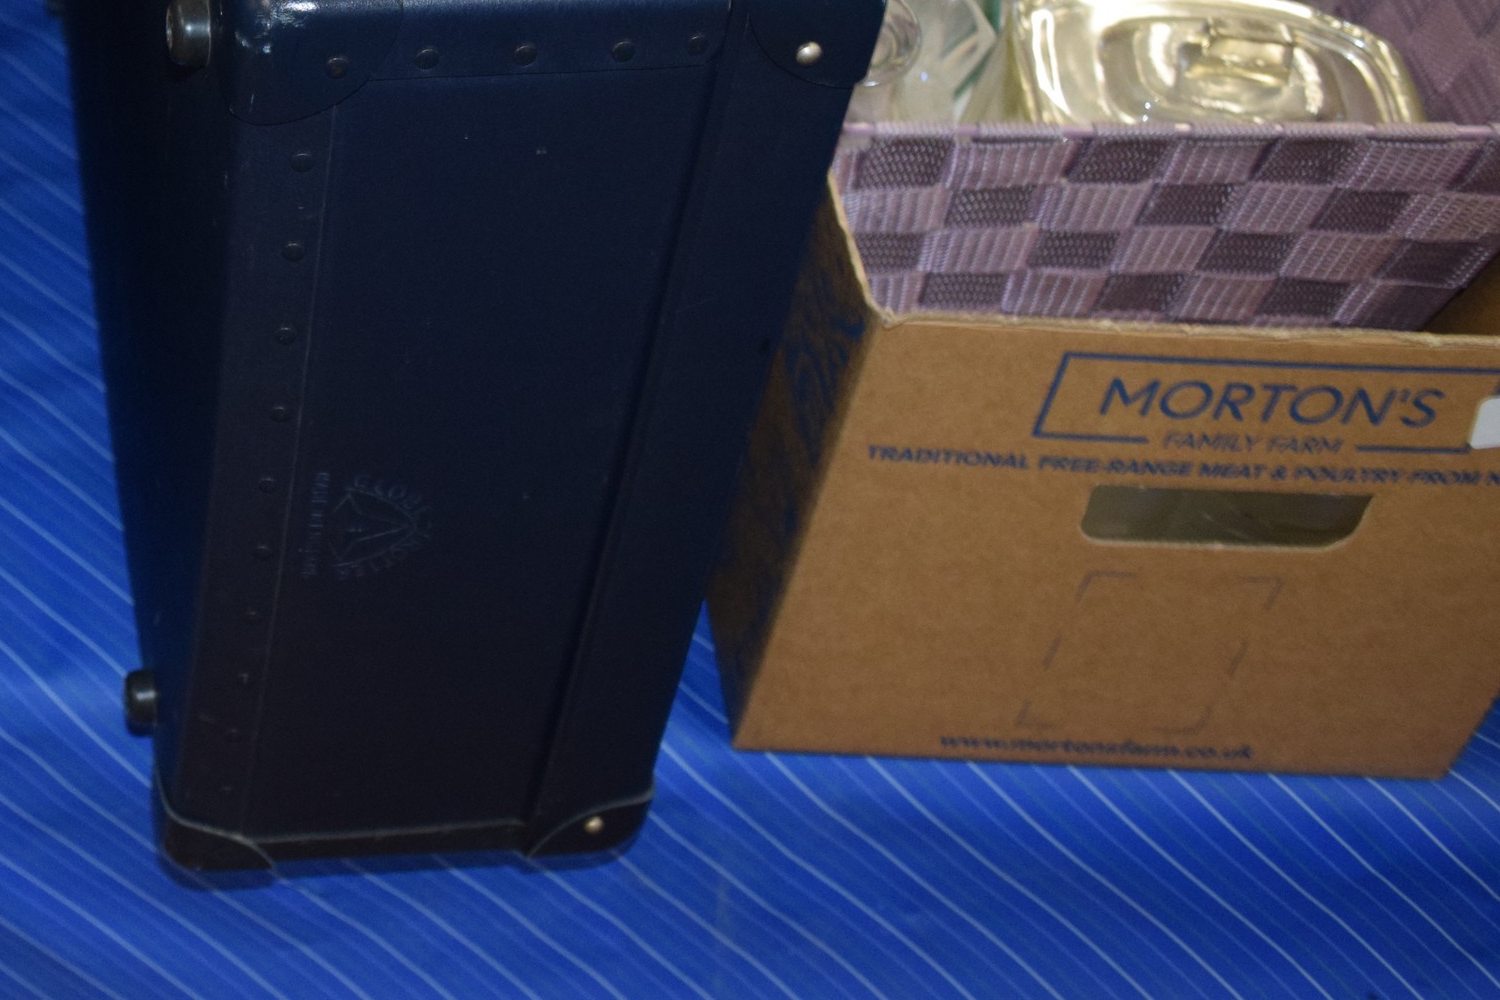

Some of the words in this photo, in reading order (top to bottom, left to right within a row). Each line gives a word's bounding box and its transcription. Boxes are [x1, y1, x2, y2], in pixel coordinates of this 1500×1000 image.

[1100, 376, 1446, 428] MORTON'S
[1163, 430, 1262, 454] FAMILY
[1266, 435, 1344, 454] FARM
[868, 445, 1029, 470] TRADITIONAL
[1199, 461, 1267, 480] MEAT
[1271, 465, 1287, 481] &
[1293, 464, 1401, 483] POULTRY
